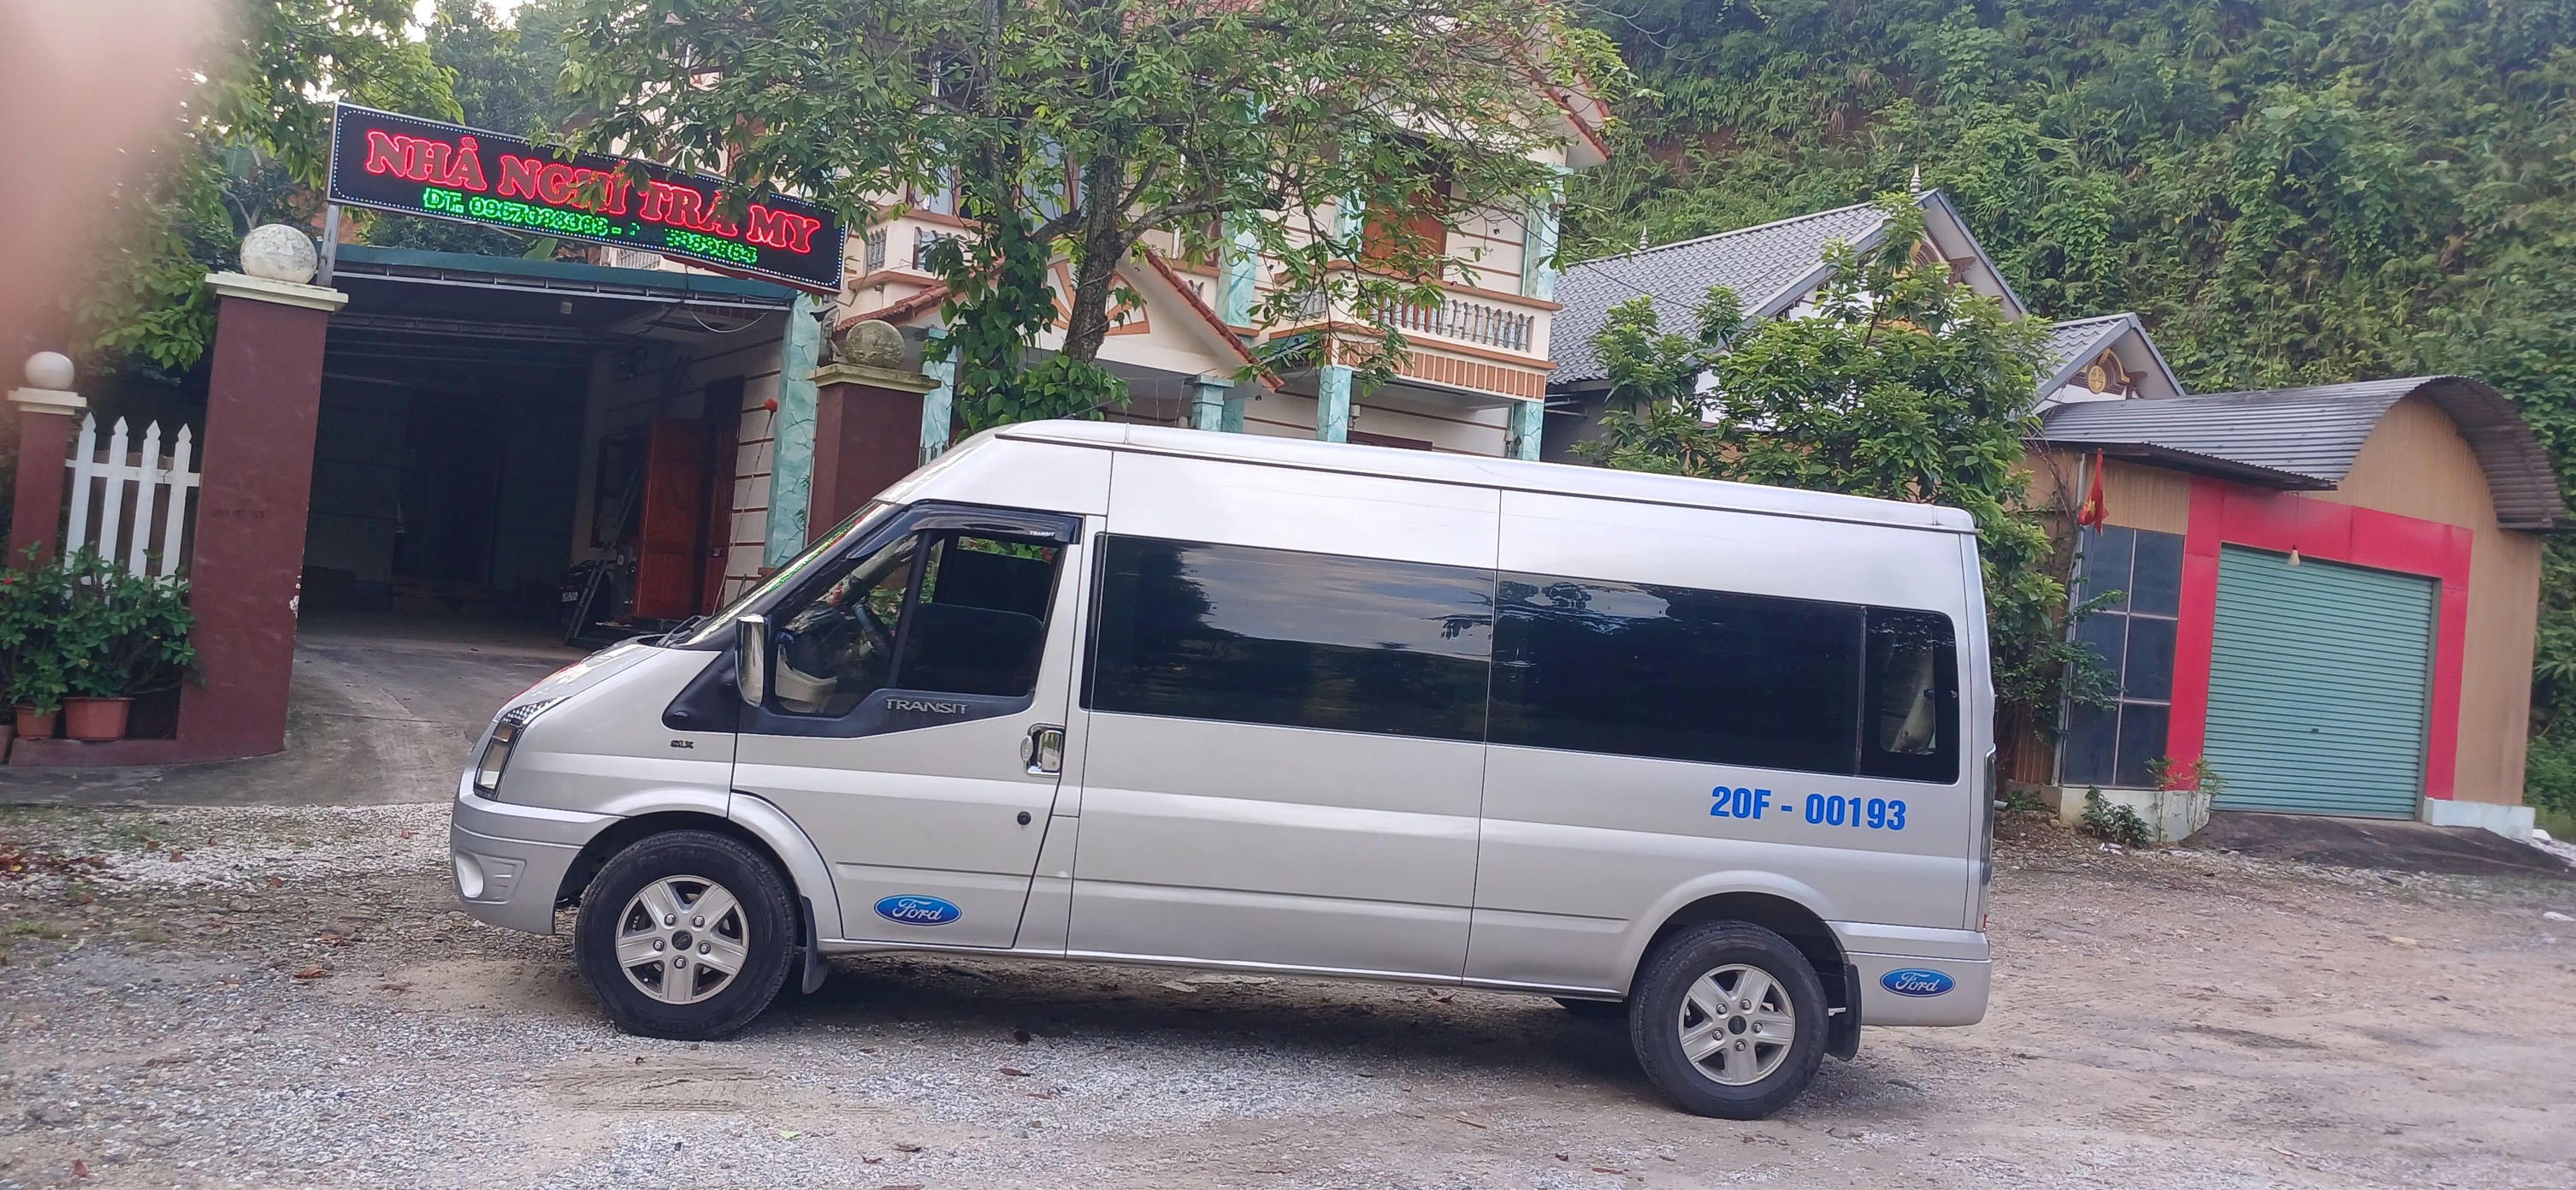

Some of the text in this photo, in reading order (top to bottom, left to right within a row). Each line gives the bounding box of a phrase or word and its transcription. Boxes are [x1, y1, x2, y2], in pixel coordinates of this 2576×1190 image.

[366, 130, 487, 192] NHÀ
[746, 204, 821, 254] MY
[885, 698, 969, 714] TRANSIT
[1710, 785, 1772, 820] 20F
[1805, 793, 1907, 831] 00193
[892, 898, 944, 921] Ford
[1894, 971, 1941, 992] Ford
